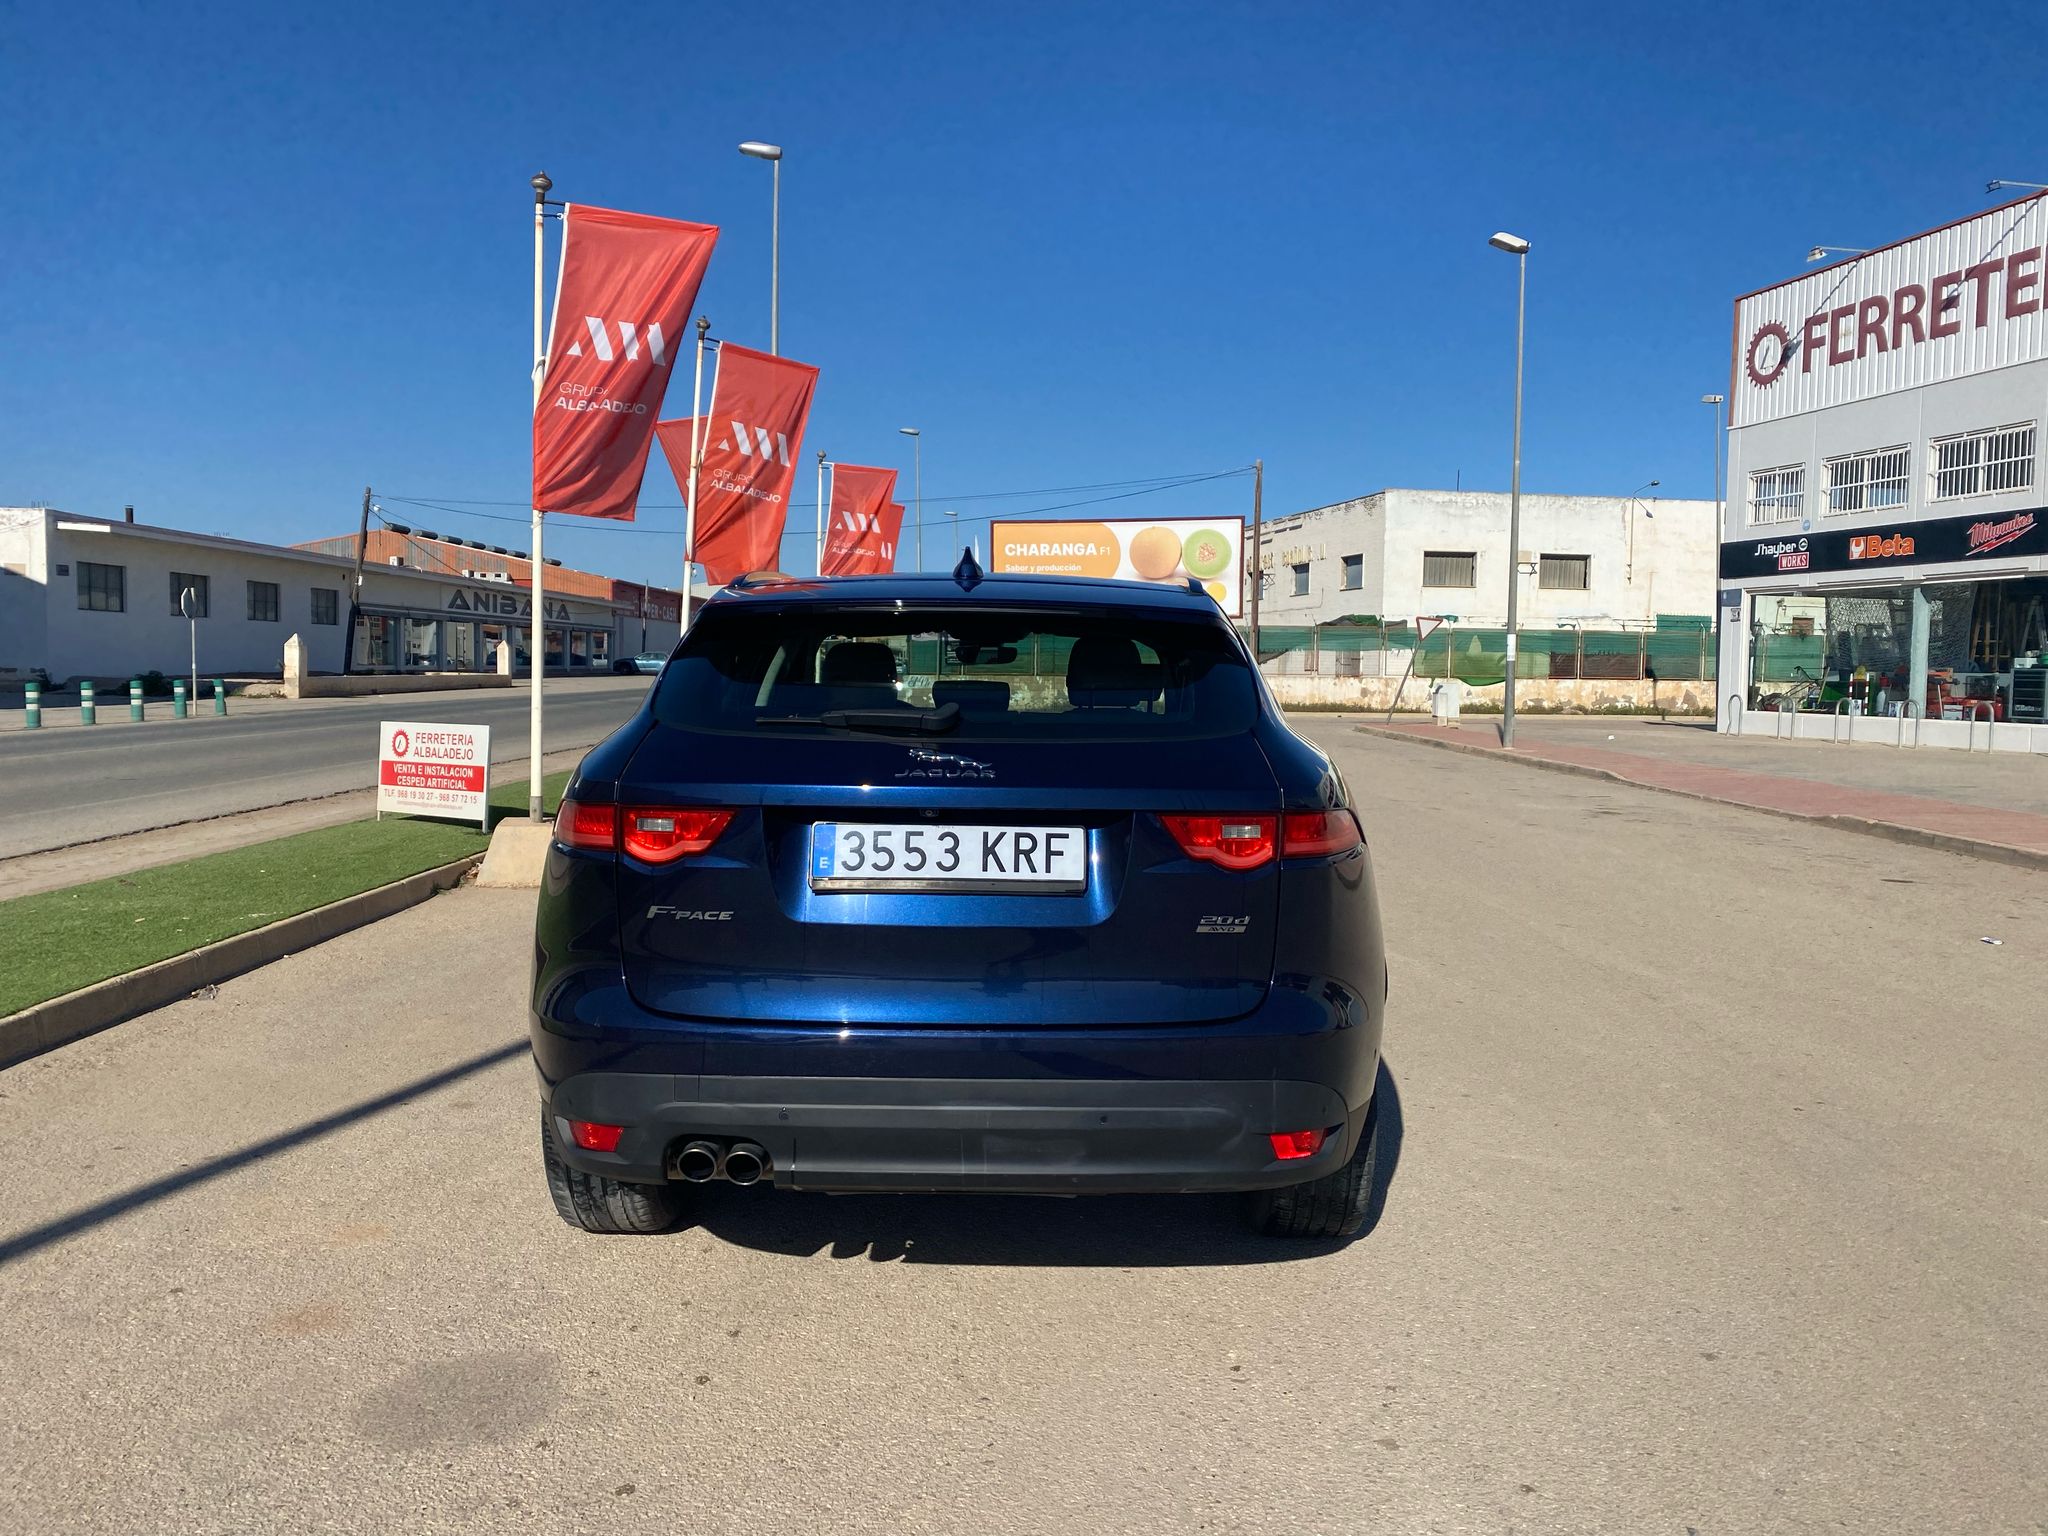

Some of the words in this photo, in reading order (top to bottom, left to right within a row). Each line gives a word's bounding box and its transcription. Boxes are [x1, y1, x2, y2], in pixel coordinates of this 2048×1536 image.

[1802, 244, 2048, 373] FERRETE
[555, 397, 647, 414] ALBAADEJO
[1004, 543, 1097, 556] CHARANGA
[1099, 547, 1111, 556] F1
[1867, 533, 1915, 558] Beta
[1005, 564, 1029, 572] Sabor
[1030, 565, 1035, 573] y
[1036, 564, 1082, 573] producción
[1781, 555, 1807, 568] WORKS
[448, 589, 571, 621] ANIBANA
[415, 732, 474, 746] FERRETERIA
[413, 746, 474, 760] ALBALADEJO
[393, 763, 416, 774] VENTA
[417, 765, 423, 775] E
[424, 765, 474, 778] INSTALACION
[894, 768, 997, 779] JAGUAR
[397, 775, 426, 787] CESPED
[426, 778, 467, 790] ARTIFICIAL
[840, 830, 960, 872] 3553
[981, 831, 1070, 874] KRF
[819, 857, 829, 869] E
[646, 905, 734, 920] F-PACE
[1200, 915, 1251, 925] 20d
